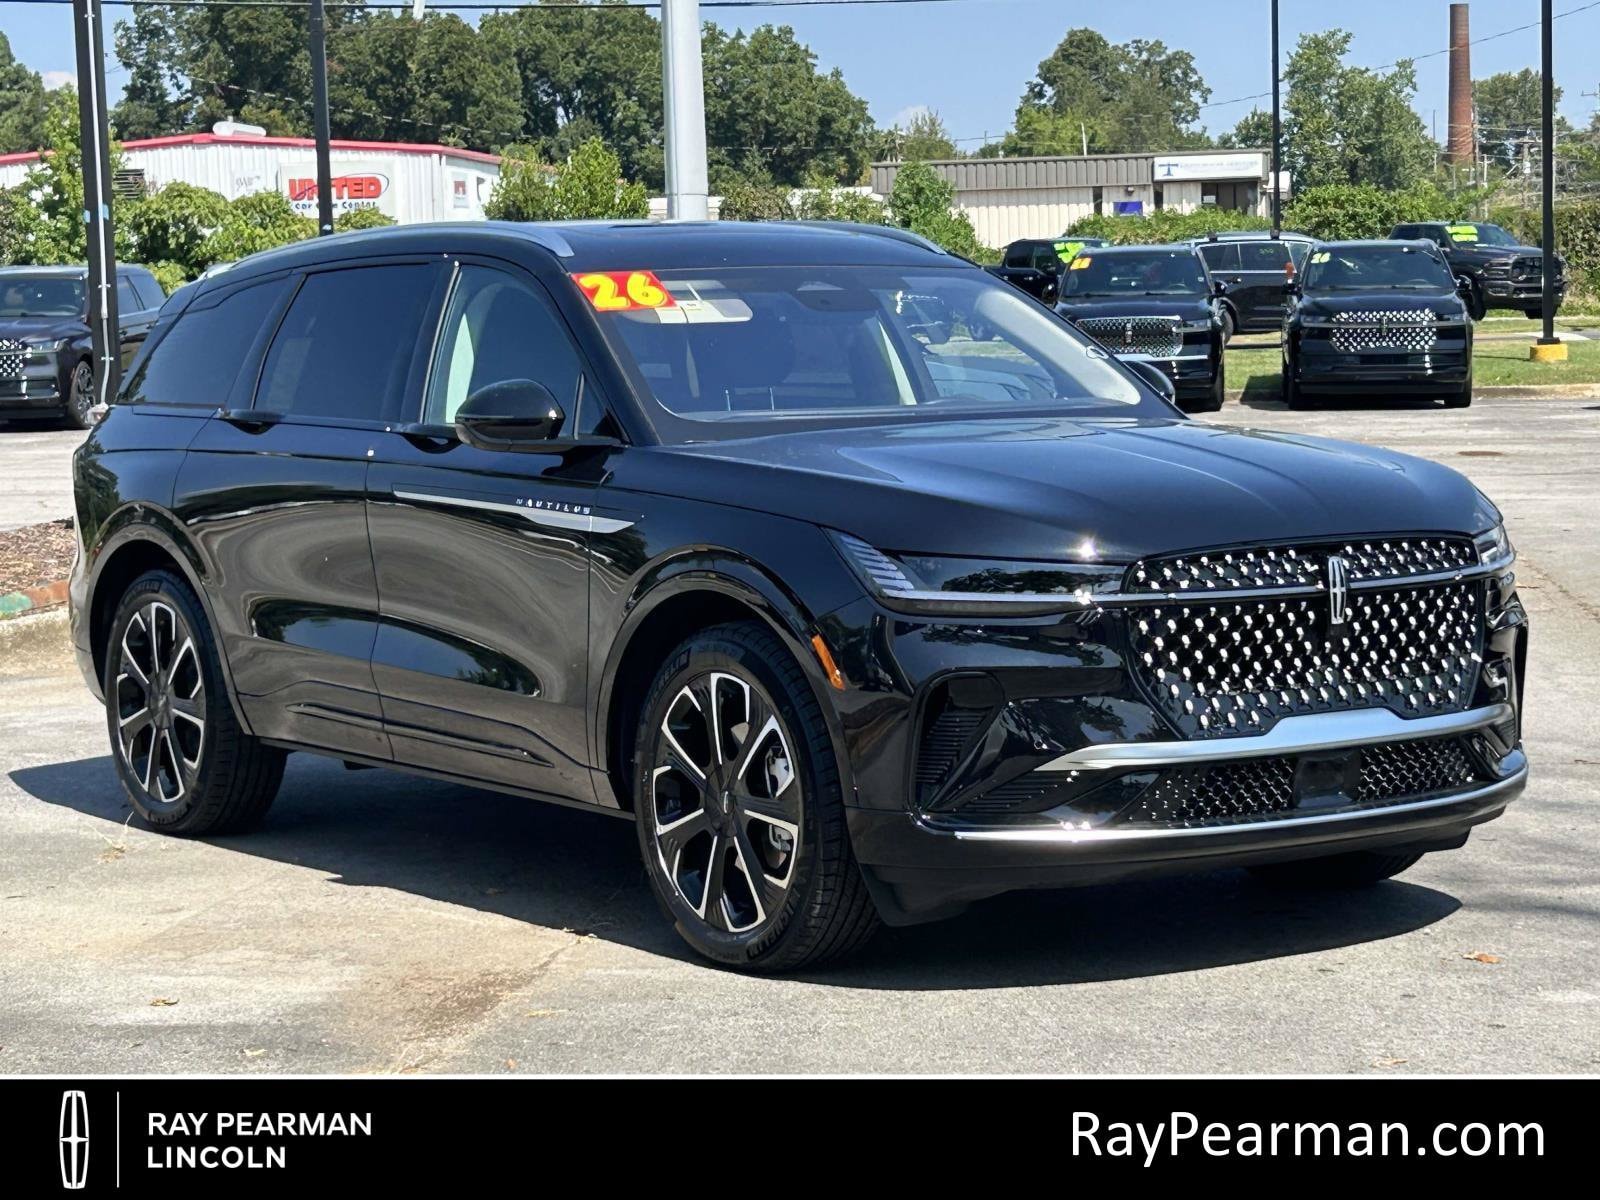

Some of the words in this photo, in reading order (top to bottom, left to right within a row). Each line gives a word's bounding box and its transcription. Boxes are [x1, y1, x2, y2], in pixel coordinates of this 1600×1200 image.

[289, 177, 382, 201] UNTED
[578, 271, 668, 309] 26
[516, 499, 591, 515] NAUTILUS
